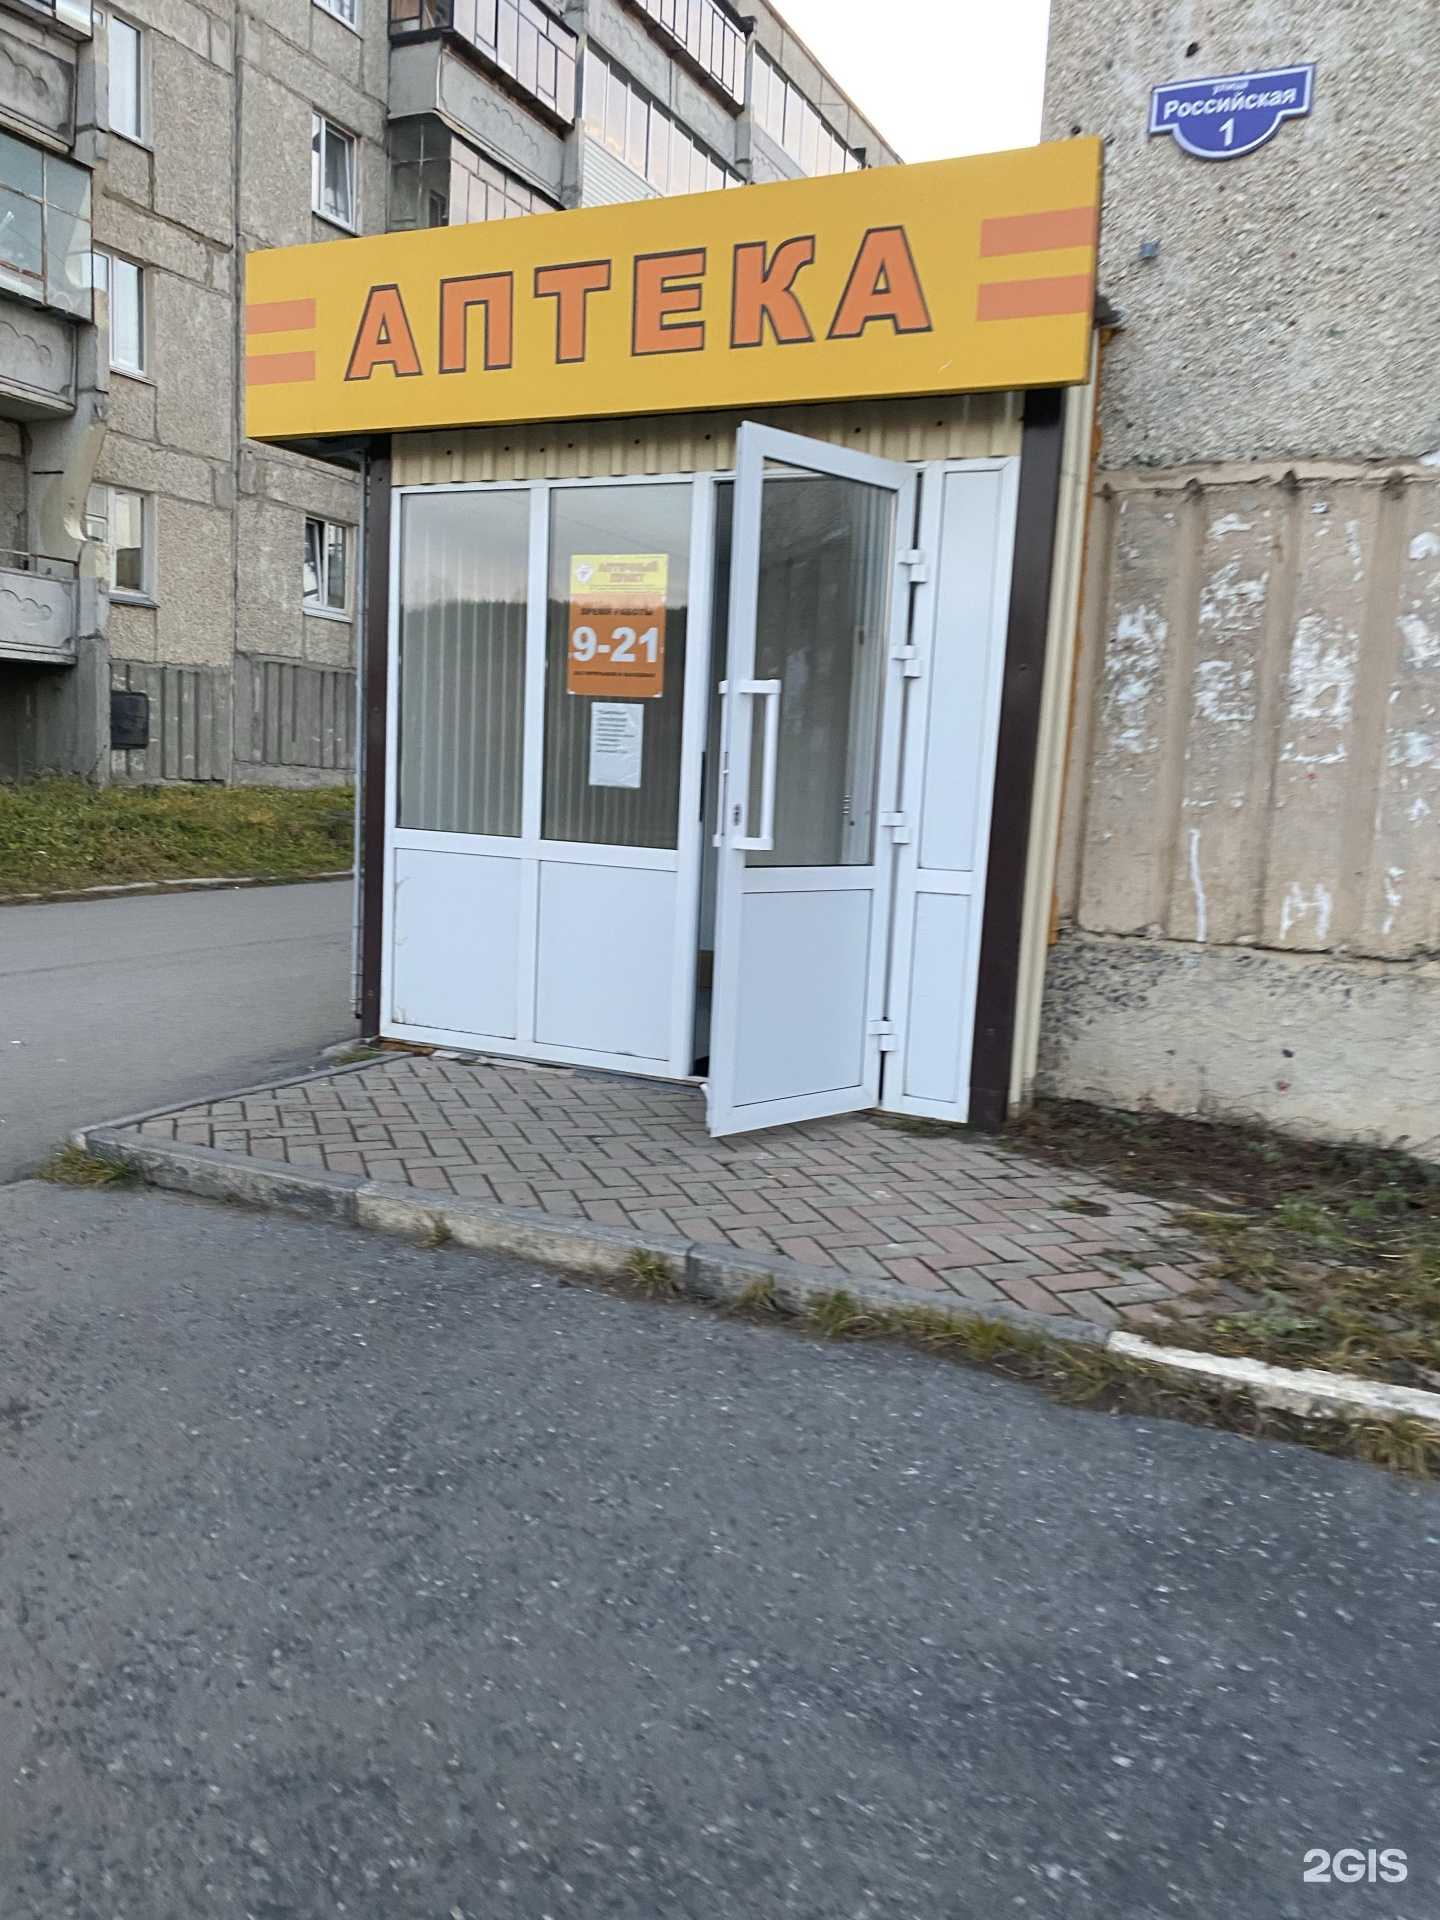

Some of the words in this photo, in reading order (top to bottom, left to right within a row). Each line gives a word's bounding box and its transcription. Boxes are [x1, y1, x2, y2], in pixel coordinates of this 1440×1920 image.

[1163, 88, 1297, 120] Российская
[1218, 117, 1235, 147] 1
[344, 225, 933, 381] АПТЕКА
[572, 625, 659, 663] 9-21
